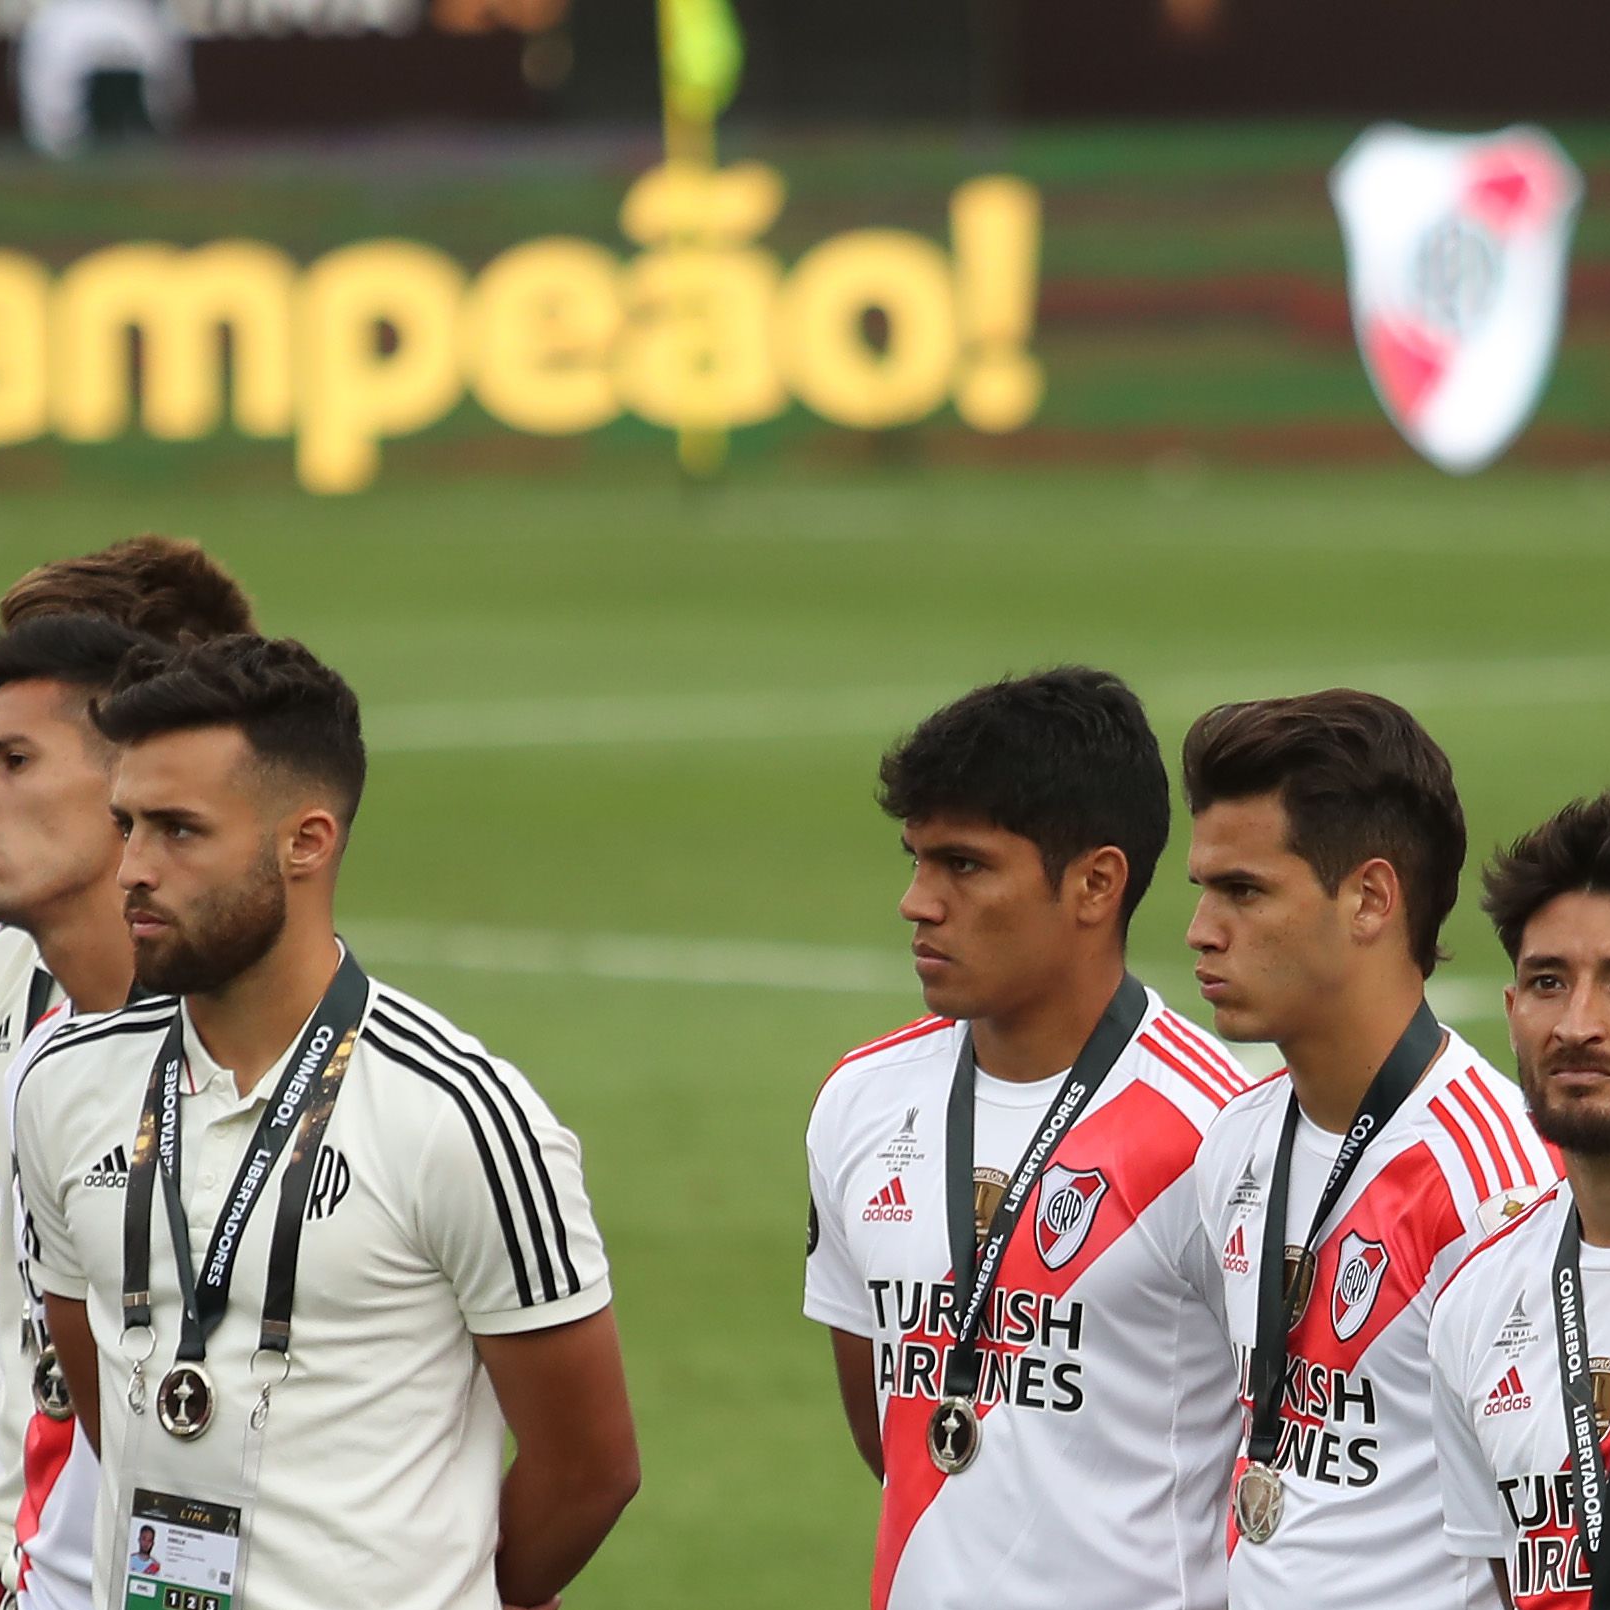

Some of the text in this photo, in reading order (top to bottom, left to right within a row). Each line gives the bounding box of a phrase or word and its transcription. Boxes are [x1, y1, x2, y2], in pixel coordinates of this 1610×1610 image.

[159, 1060, 179, 1176] ERTADORES
[206, 1024, 334, 1288] CONMEBOL LIBERTADORES
[83, 1172, 129, 1189] adida
[861, 1205, 913, 1223] adidas
[959, 1082, 1087, 1342] CONMEBOL LIBERTADORES
[866, 1279, 1084, 1351] TURISH
[1483, 1395, 1532, 1417] adidas
[1558, 1267, 1603, 1553] CONMEBOL LIBERTADORES
